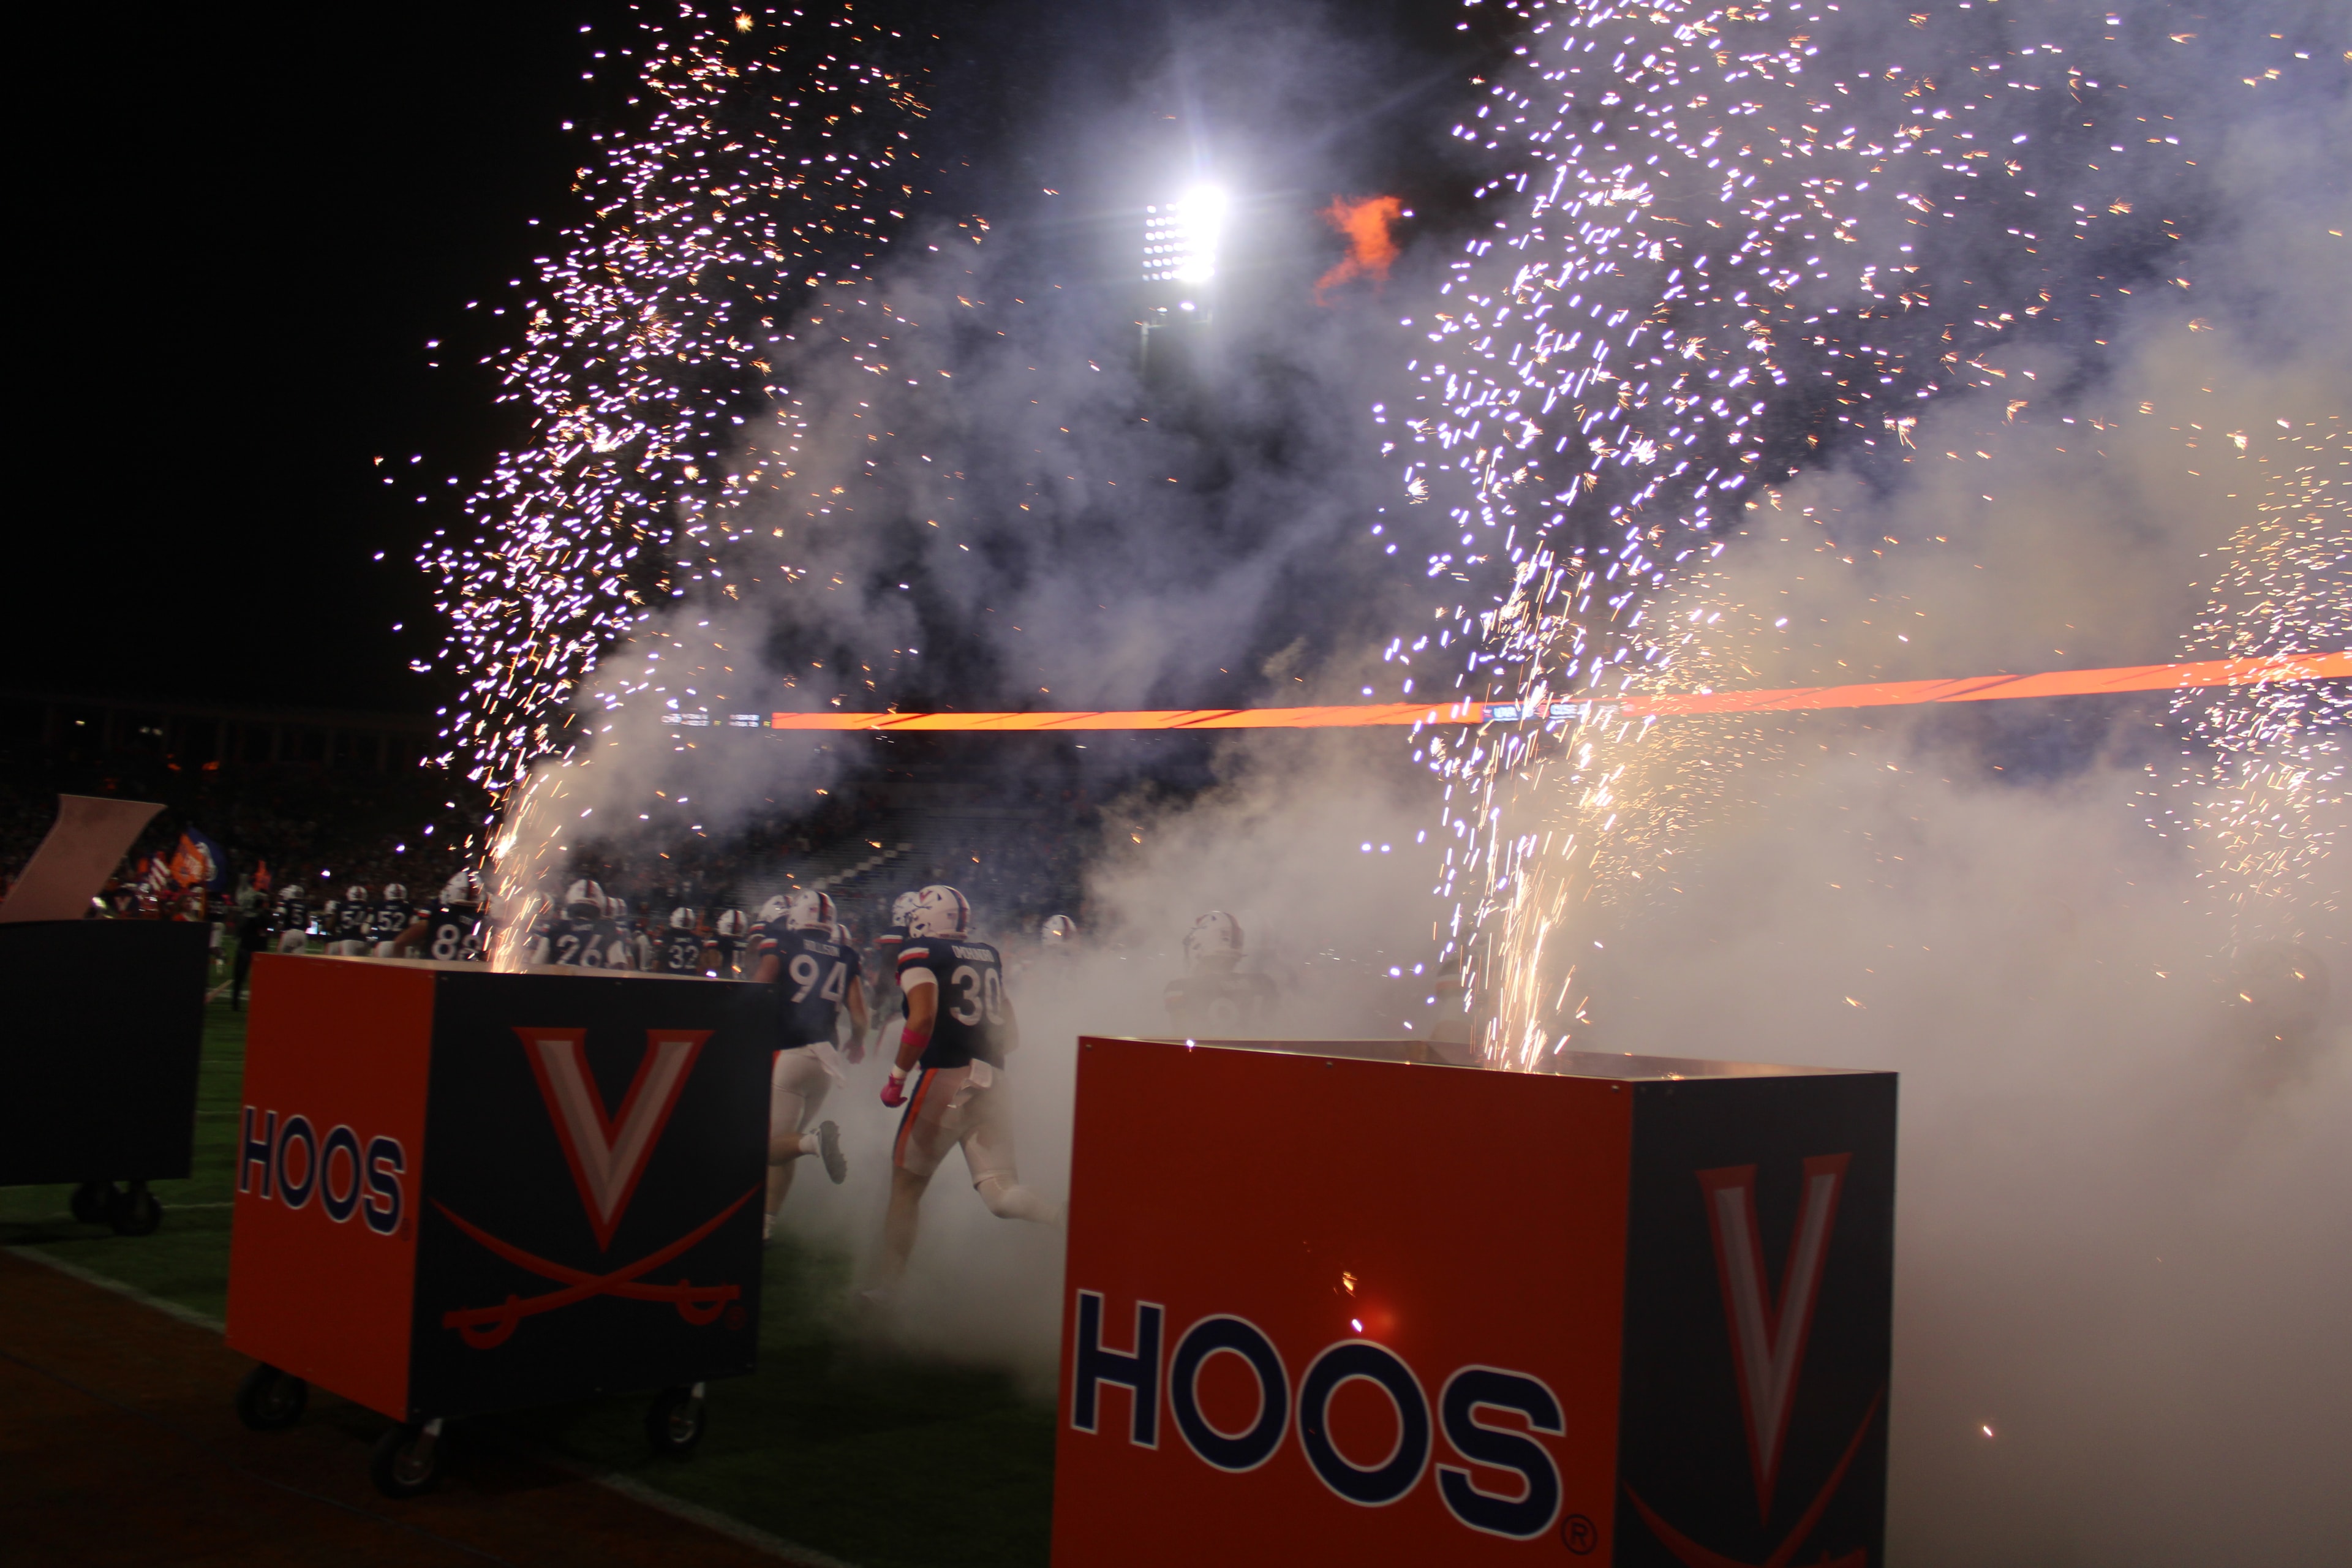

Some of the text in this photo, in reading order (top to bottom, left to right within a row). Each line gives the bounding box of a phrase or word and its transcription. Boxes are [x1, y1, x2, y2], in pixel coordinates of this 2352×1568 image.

[377, 911, 407, 932] 52
[556, 934, 603, 967] 26
[668, 945, 699, 969] 32
[788, 954, 848, 1003] 94
[950, 965, 1005, 1026] 30
[238, 1105, 407, 1236] HOOS
[511, 1027, 715, 1253] V
[1694, 1152, 1853, 1528] V
[1070, 1288, 1567, 1541] HOOS
